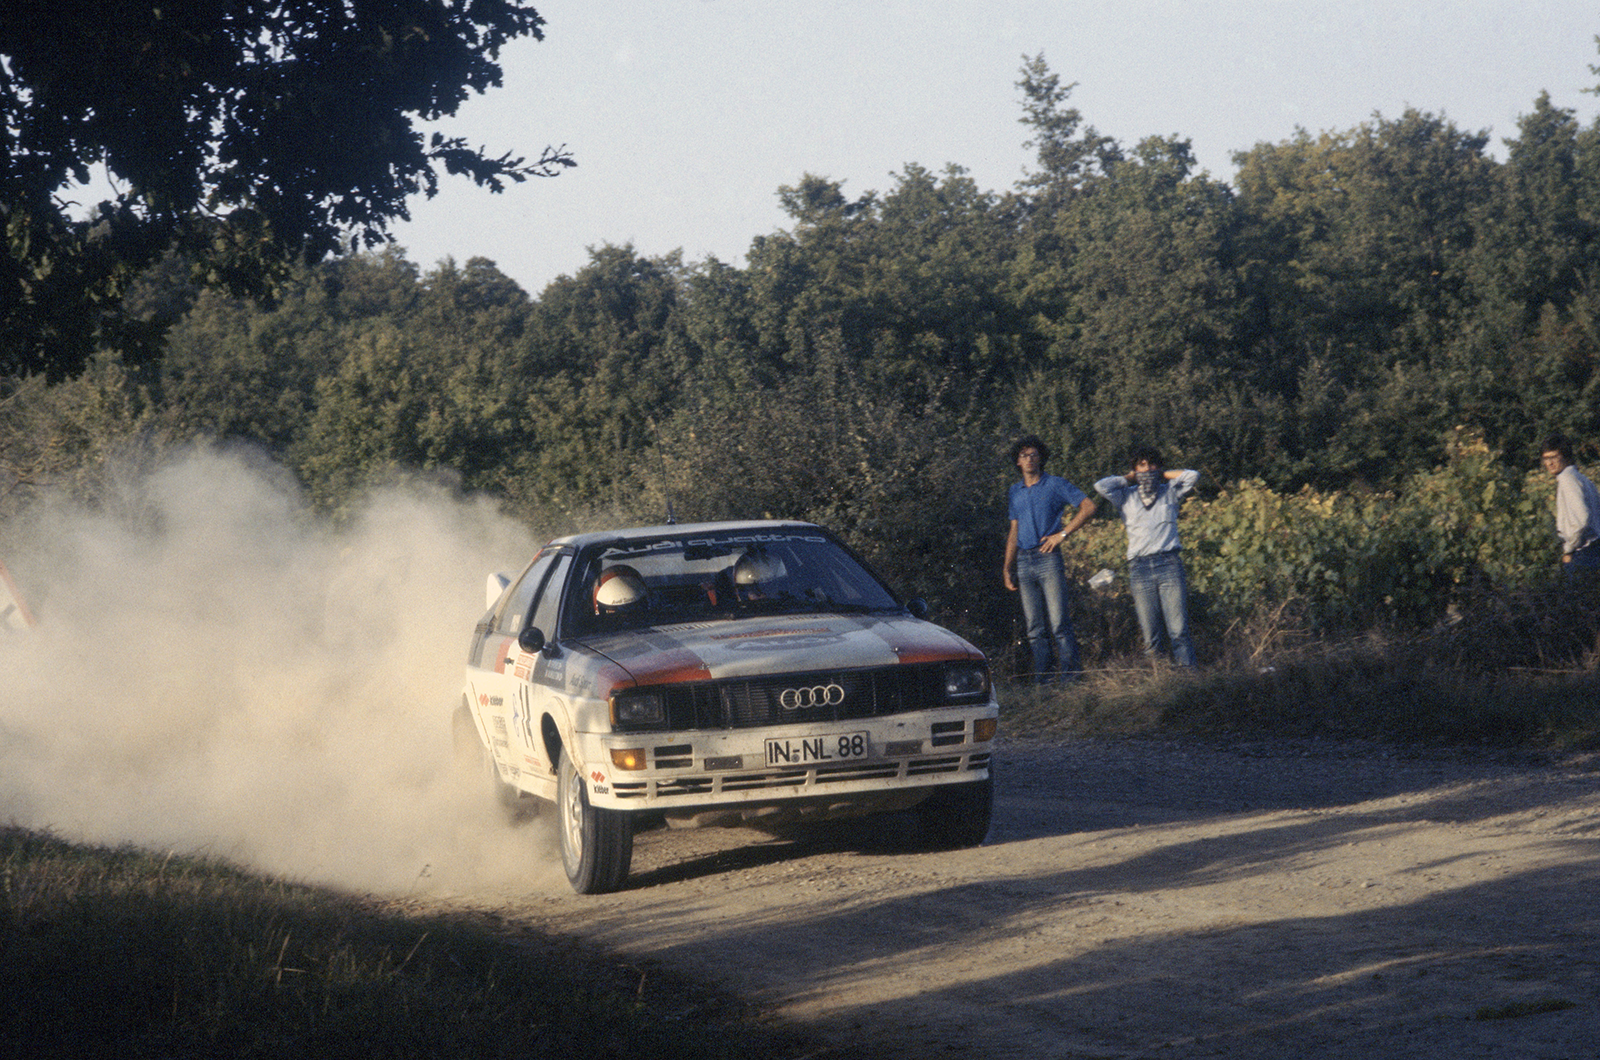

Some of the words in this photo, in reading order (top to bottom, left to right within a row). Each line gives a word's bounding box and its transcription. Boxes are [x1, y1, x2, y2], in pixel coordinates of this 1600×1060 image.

[597, 540, 683, 560] Audi
[687, 534, 827, 547] quattro
[768, 737, 832, 764] IN-NL
[838, 735, 864, 758] 88
